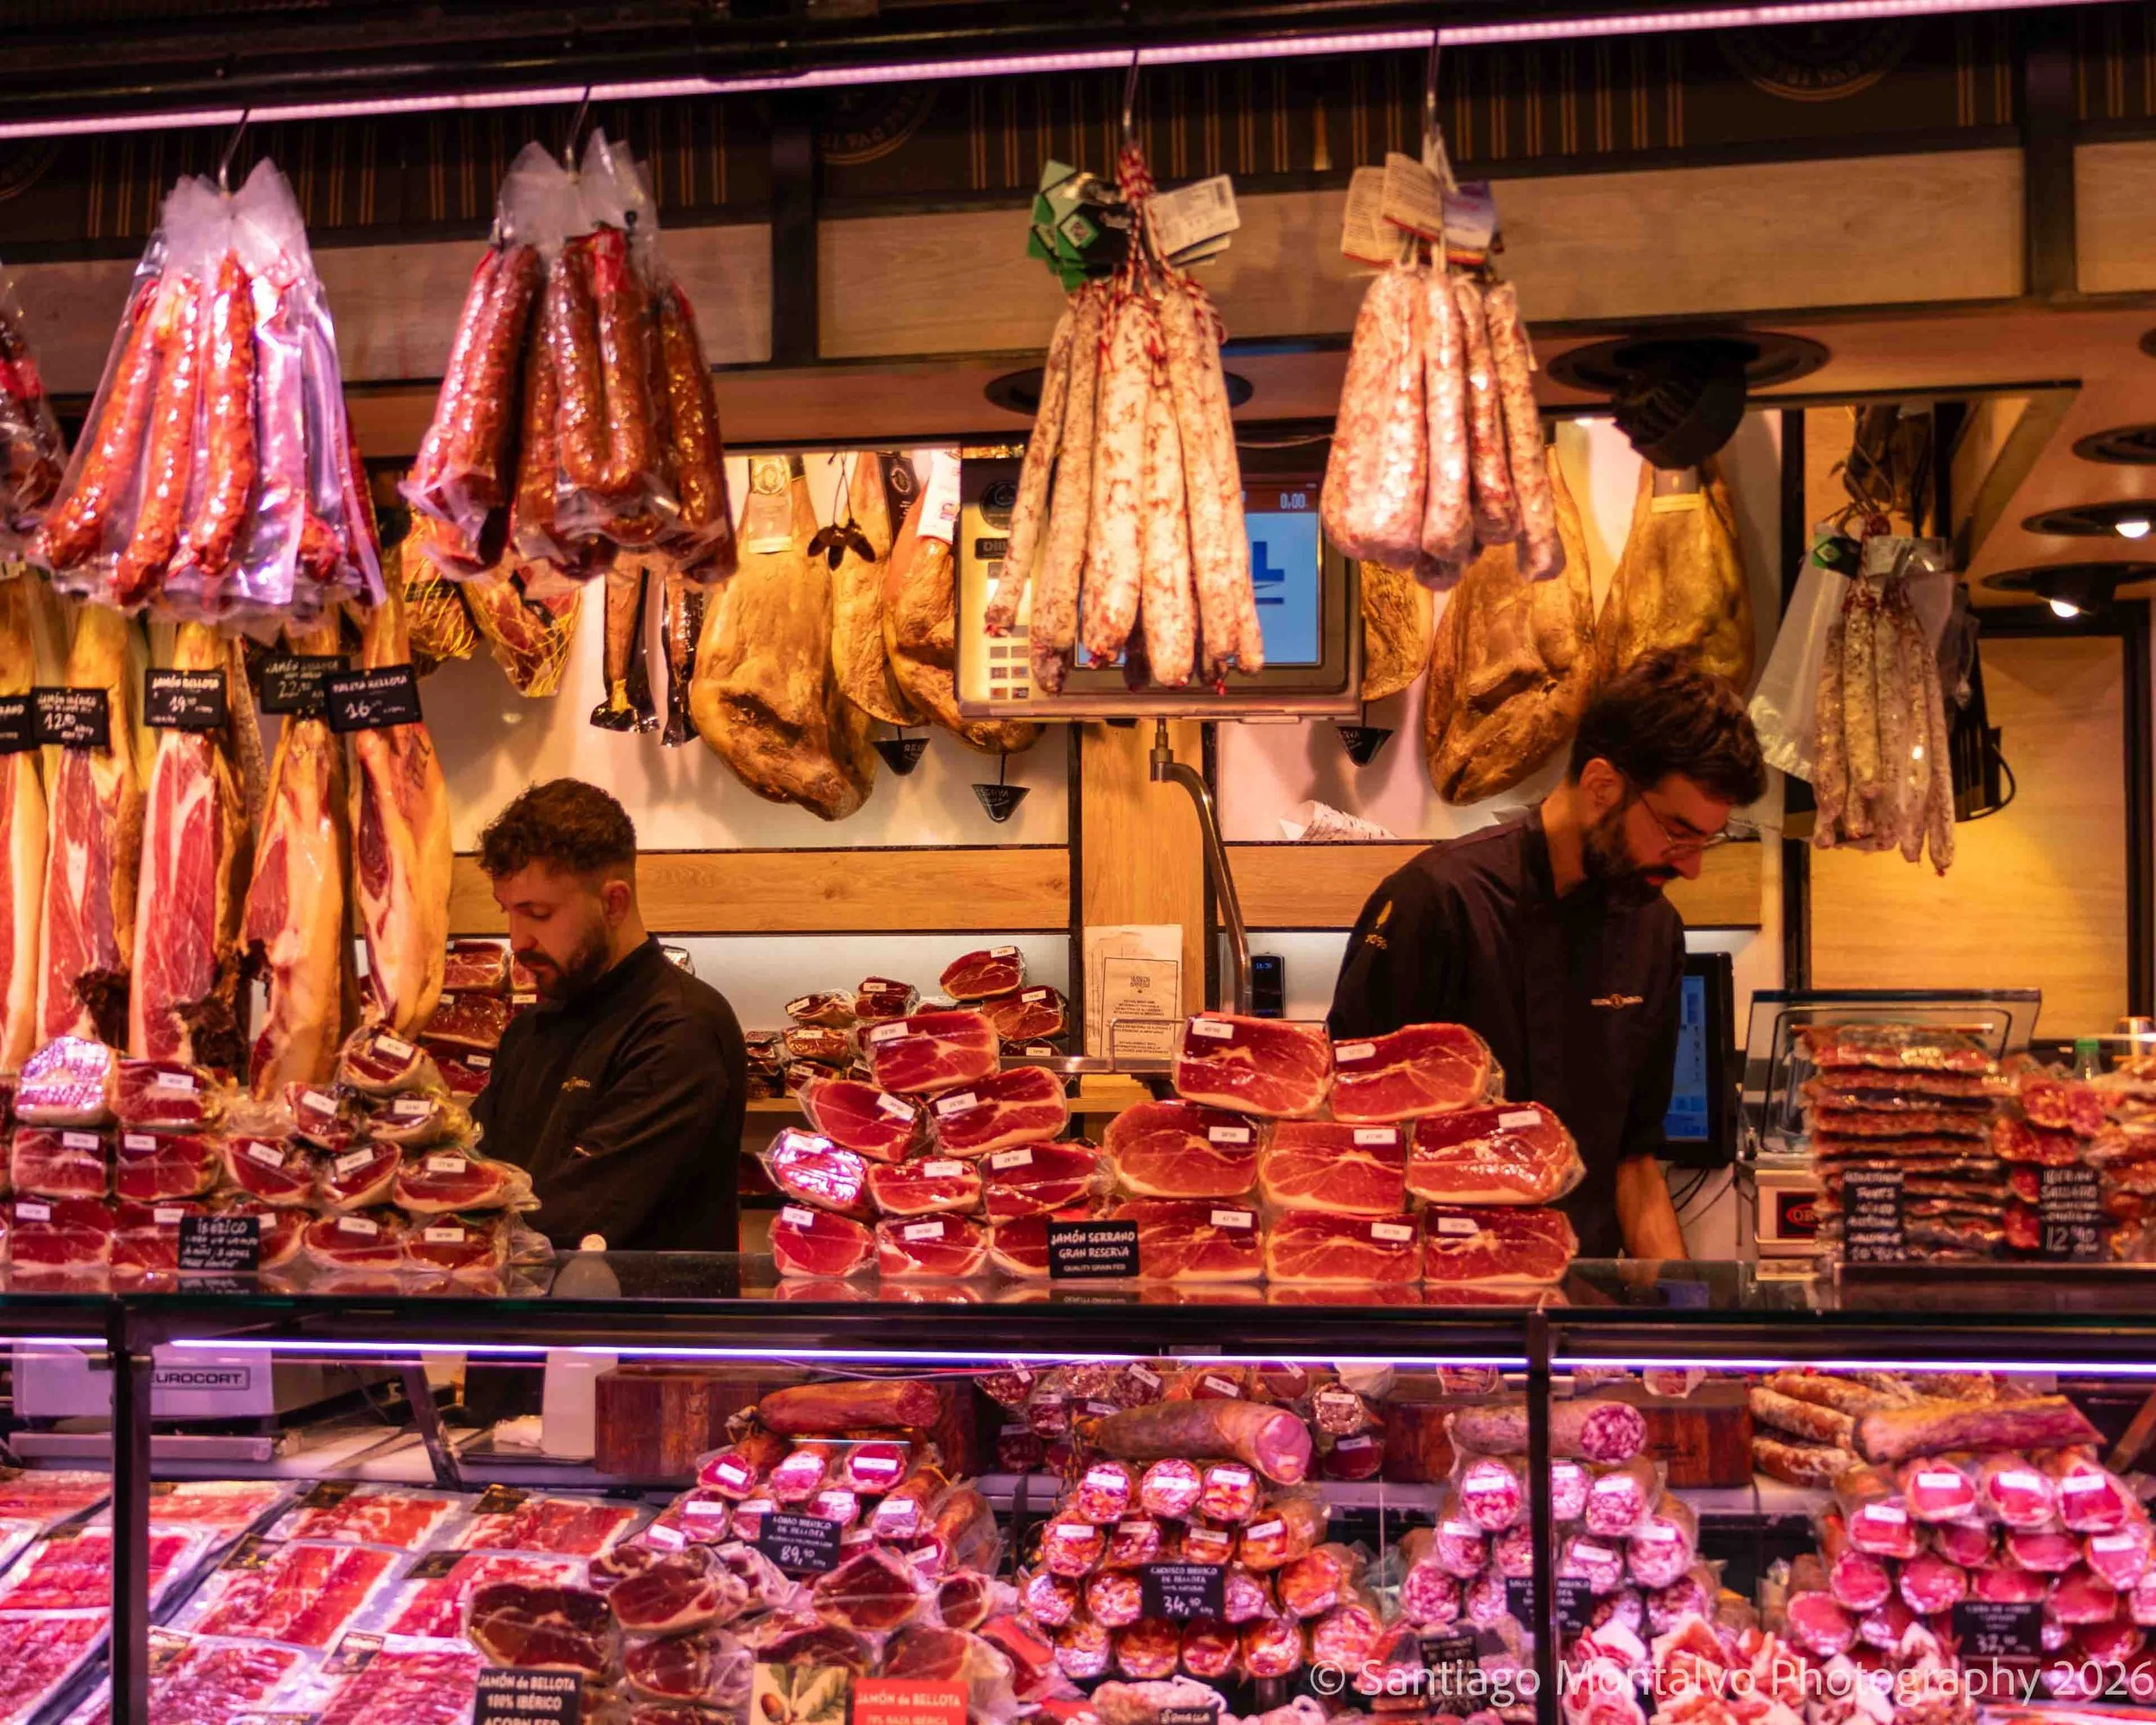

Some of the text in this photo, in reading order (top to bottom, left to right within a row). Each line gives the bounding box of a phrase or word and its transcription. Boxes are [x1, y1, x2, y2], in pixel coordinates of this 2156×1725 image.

[1050, 1229, 1136, 1245] JAMÓN SERRANO
[1058, 1246, 1130, 1259] GRAN RESERVA
[1063, 1264, 1090, 1272] QUALITY
[152, 1372, 241, 1384] UROCORT
[479, 1672, 515, 1688] JAMÓN
[530, 1677, 575, 1691] BELLOTA
[517, 1692, 562, 1710] IBÉRICO
[856, 1689, 895, 1706] JAMÓN
[912, 1693, 962, 1708] BELLOTA
